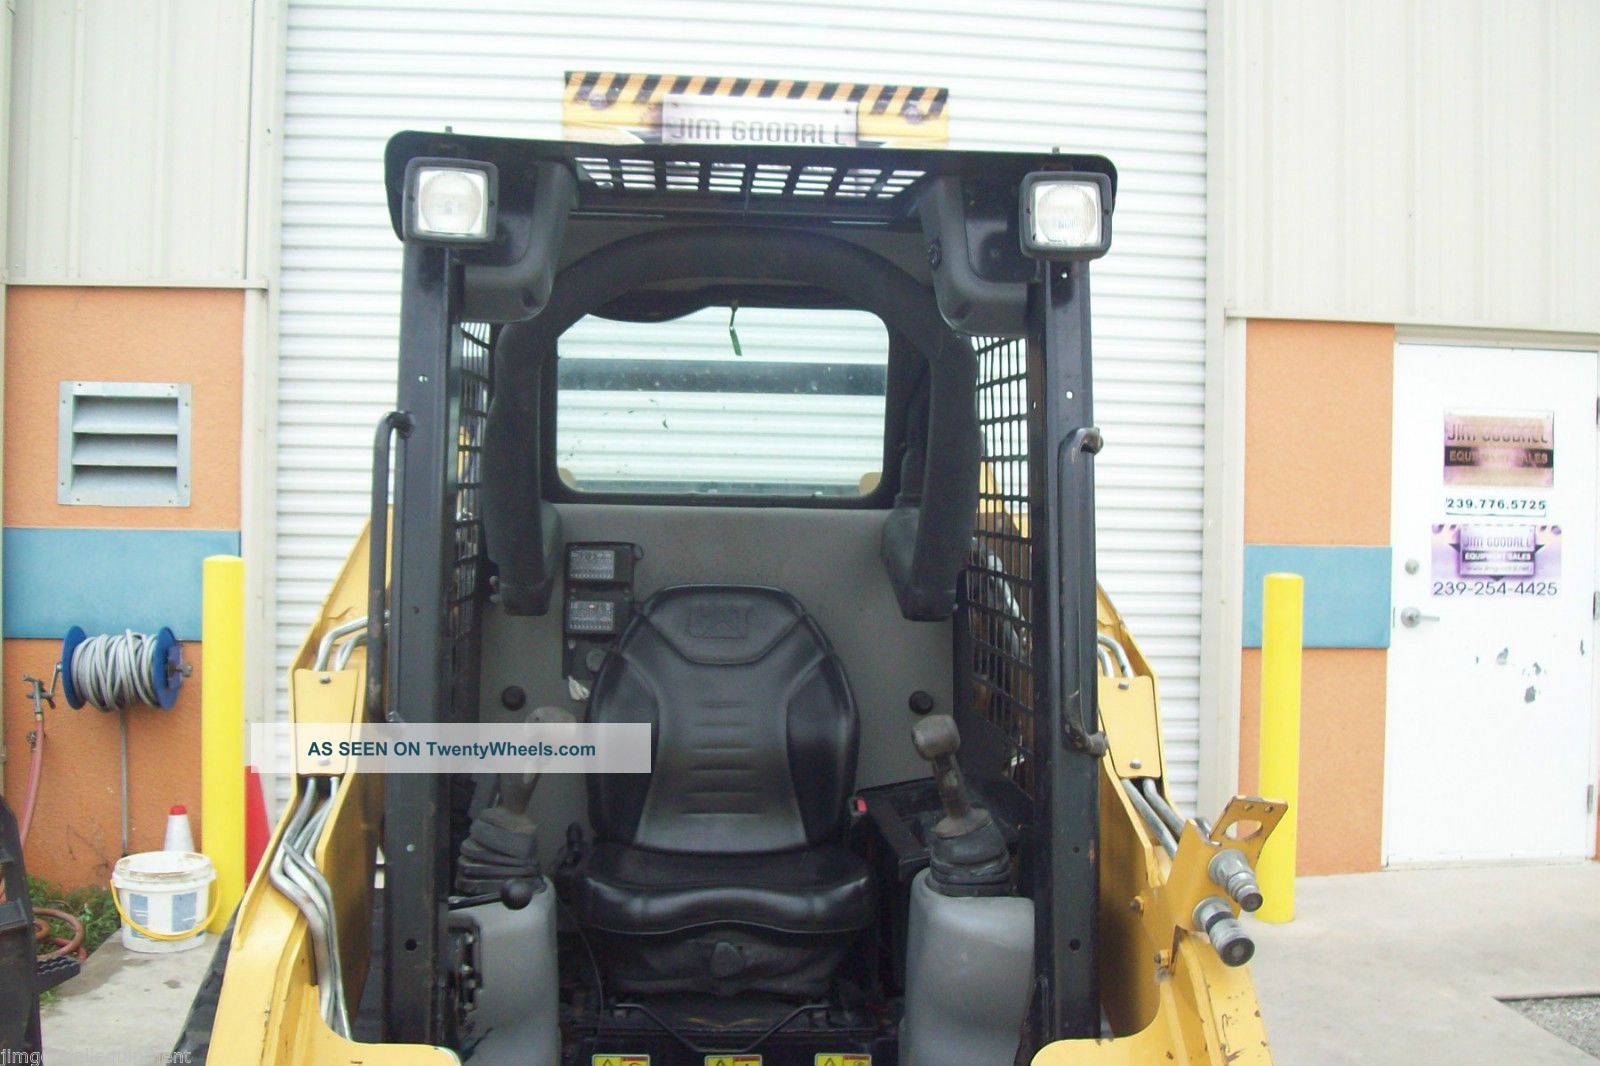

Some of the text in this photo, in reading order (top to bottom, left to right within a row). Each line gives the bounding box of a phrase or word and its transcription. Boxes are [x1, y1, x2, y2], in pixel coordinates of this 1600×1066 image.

[671, 118, 847, 146] JIM GOODALL
[1447, 498, 1546, 510] 239.776.5725
[1464, 551, 1505, 561] EQUIP
[1433, 582, 1558, 596] 239-254-4425
